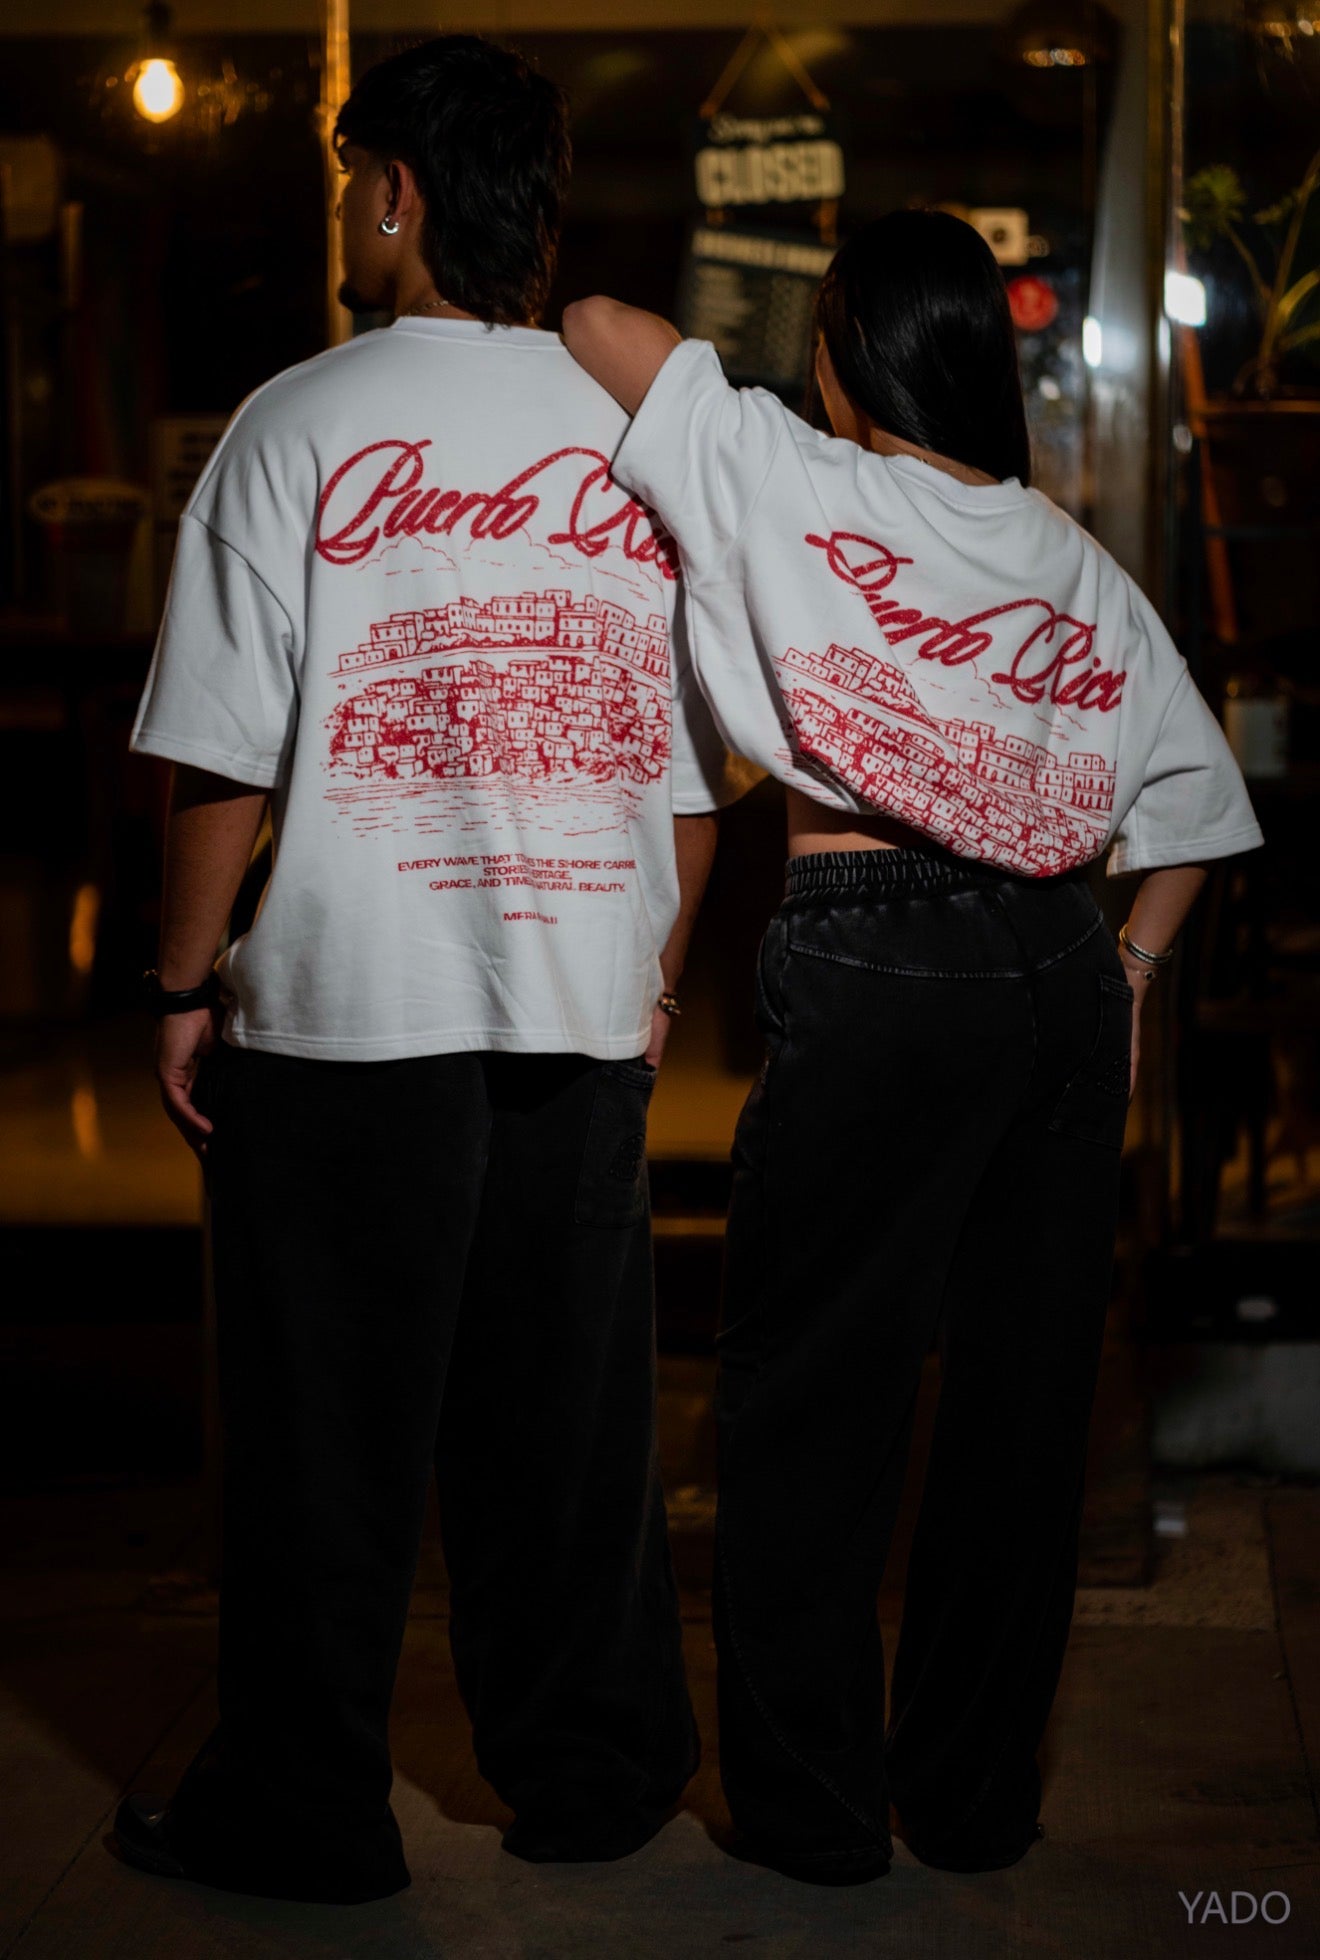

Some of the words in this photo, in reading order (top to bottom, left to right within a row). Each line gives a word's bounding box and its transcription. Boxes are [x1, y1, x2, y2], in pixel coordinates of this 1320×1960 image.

[315, 440, 612, 564] Puerto
[991, 613, 1127, 712] Rico
[398, 858, 441, 871] EVERY
[443, 856, 479, 866] WAVE
[480, 854, 511, 865] THAT
[535, 858, 555, 868] THE
[557, 860, 601, 870] SHORE
[429, 878, 476, 890] GRACE,
[477, 878, 502, 888] AND
